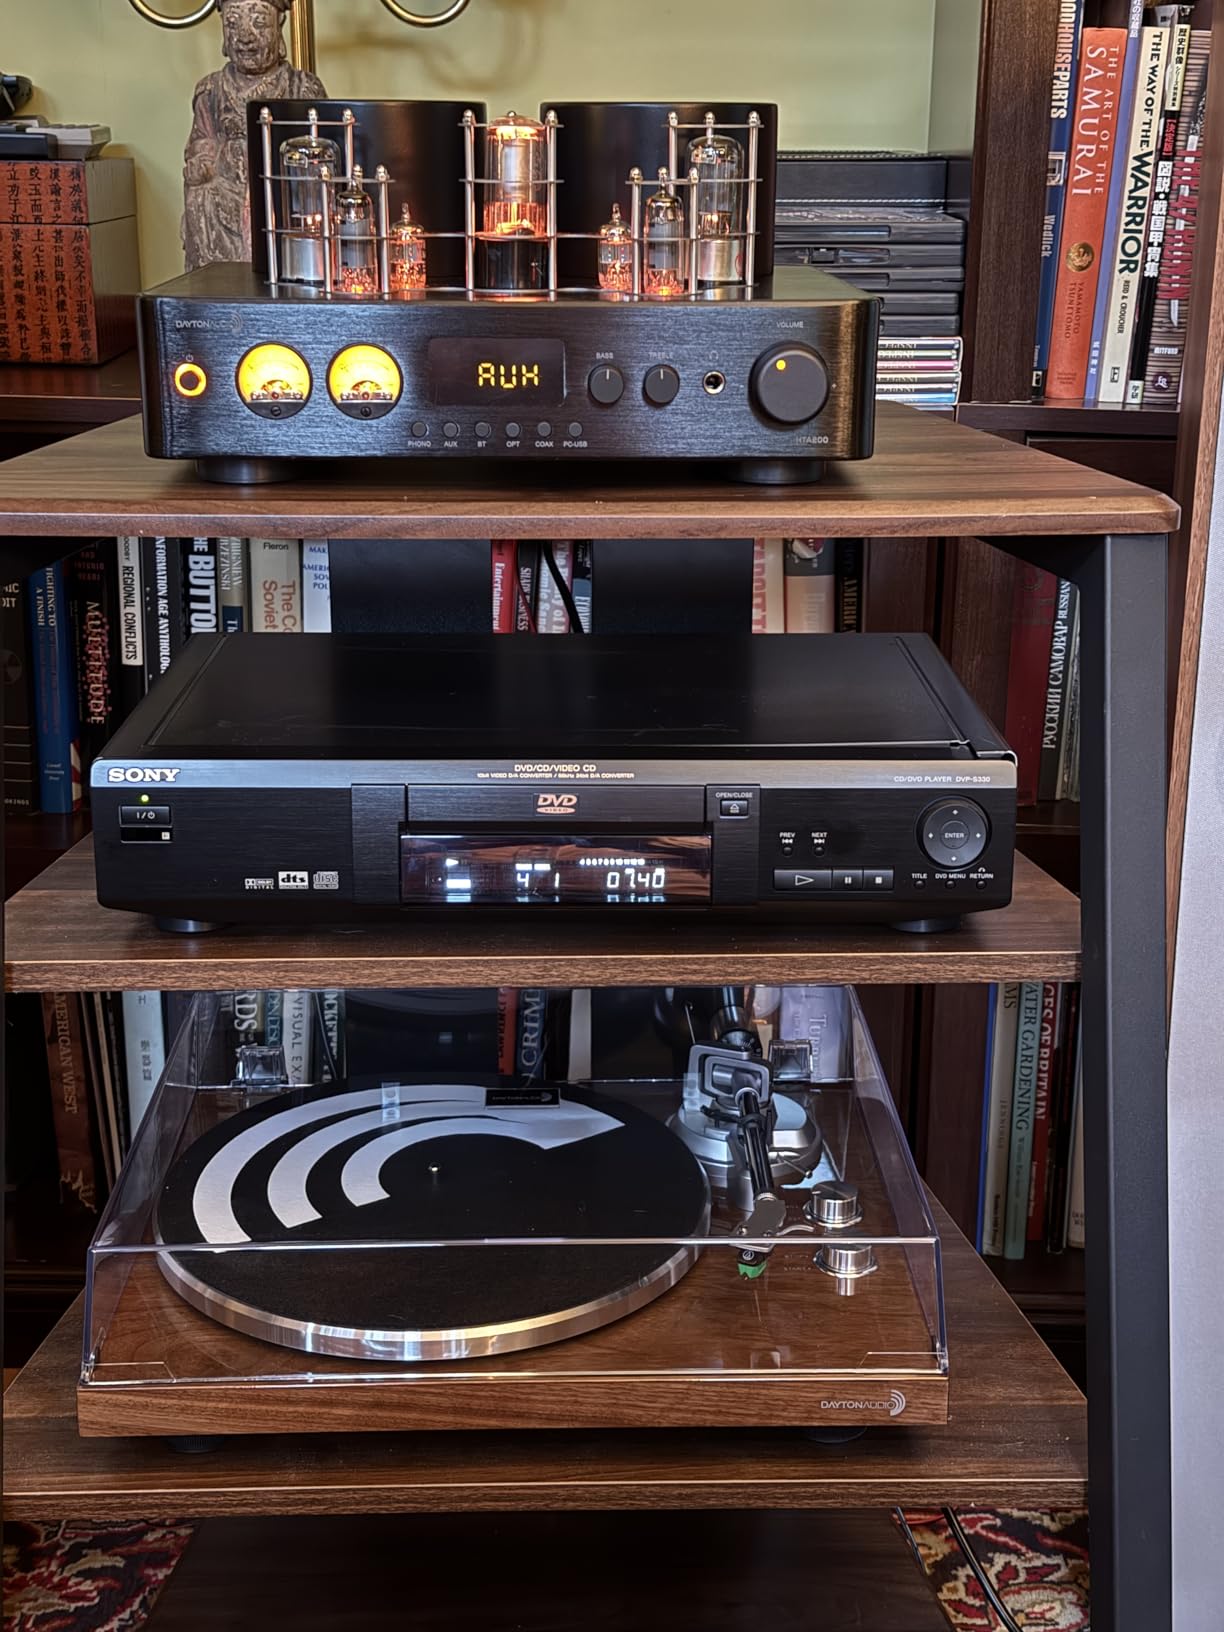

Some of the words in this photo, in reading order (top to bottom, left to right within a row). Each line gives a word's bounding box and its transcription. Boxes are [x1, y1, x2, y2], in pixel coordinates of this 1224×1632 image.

[1106, 45, 1120, 79] THE
[1149, 31, 1163, 62] THE
[1145, 64, 1159, 95] WAY
[1072, 46, 1107, 196] SAMURAI
[1102, 88, 1115, 121] ART
[1143, 96, 1155, 116] OF
[1099, 129, 1111, 152] OF
[1139, 119, 1153, 149] THE
[1094, 160, 1107, 194] THE
[1118, 149, 1154, 275] WARRIOR
[1041, 214, 1056, 257] Wedlick
[1065, 282, 1077, 340] TSUNETOMO
[1073, 282, 1086, 335] YAMAMOTO
[596, 352, 614, 360] BASS
[155, 537, 167, 599] NFORMATION
[219, 537, 231, 591] RZEZINSKI
[122, 565, 136, 610] REGIONAL
[263, 580, 278, 630] Soviet
[281, 580, 296, 617] The
[48, 613, 57, 627] TO
[157, 599, 169, 616] AGE
[124, 611, 137, 661] CONFLICTS
[1049, 620, 1069, 686] САМОВАР
[86, 601, 105, 725] MULTITUDE
[107, 767, 181, 783] SONY
[514, 764, 580, 772] DVD/CD/VIDEO
[582, 764, 597, 772] CD
[893, 775, 923, 783] CD/DVD
[924, 775, 952, 783] PLAYER
[955, 775, 991, 783] DVP-S330
[537, 793, 578, 806] DVD
[280, 873, 307, 884] dts
[291, 996, 304, 1049] VISUAL
[61, 1071, 78, 1114] WEST
[1015, 1031, 1036, 1131] GARDENING
